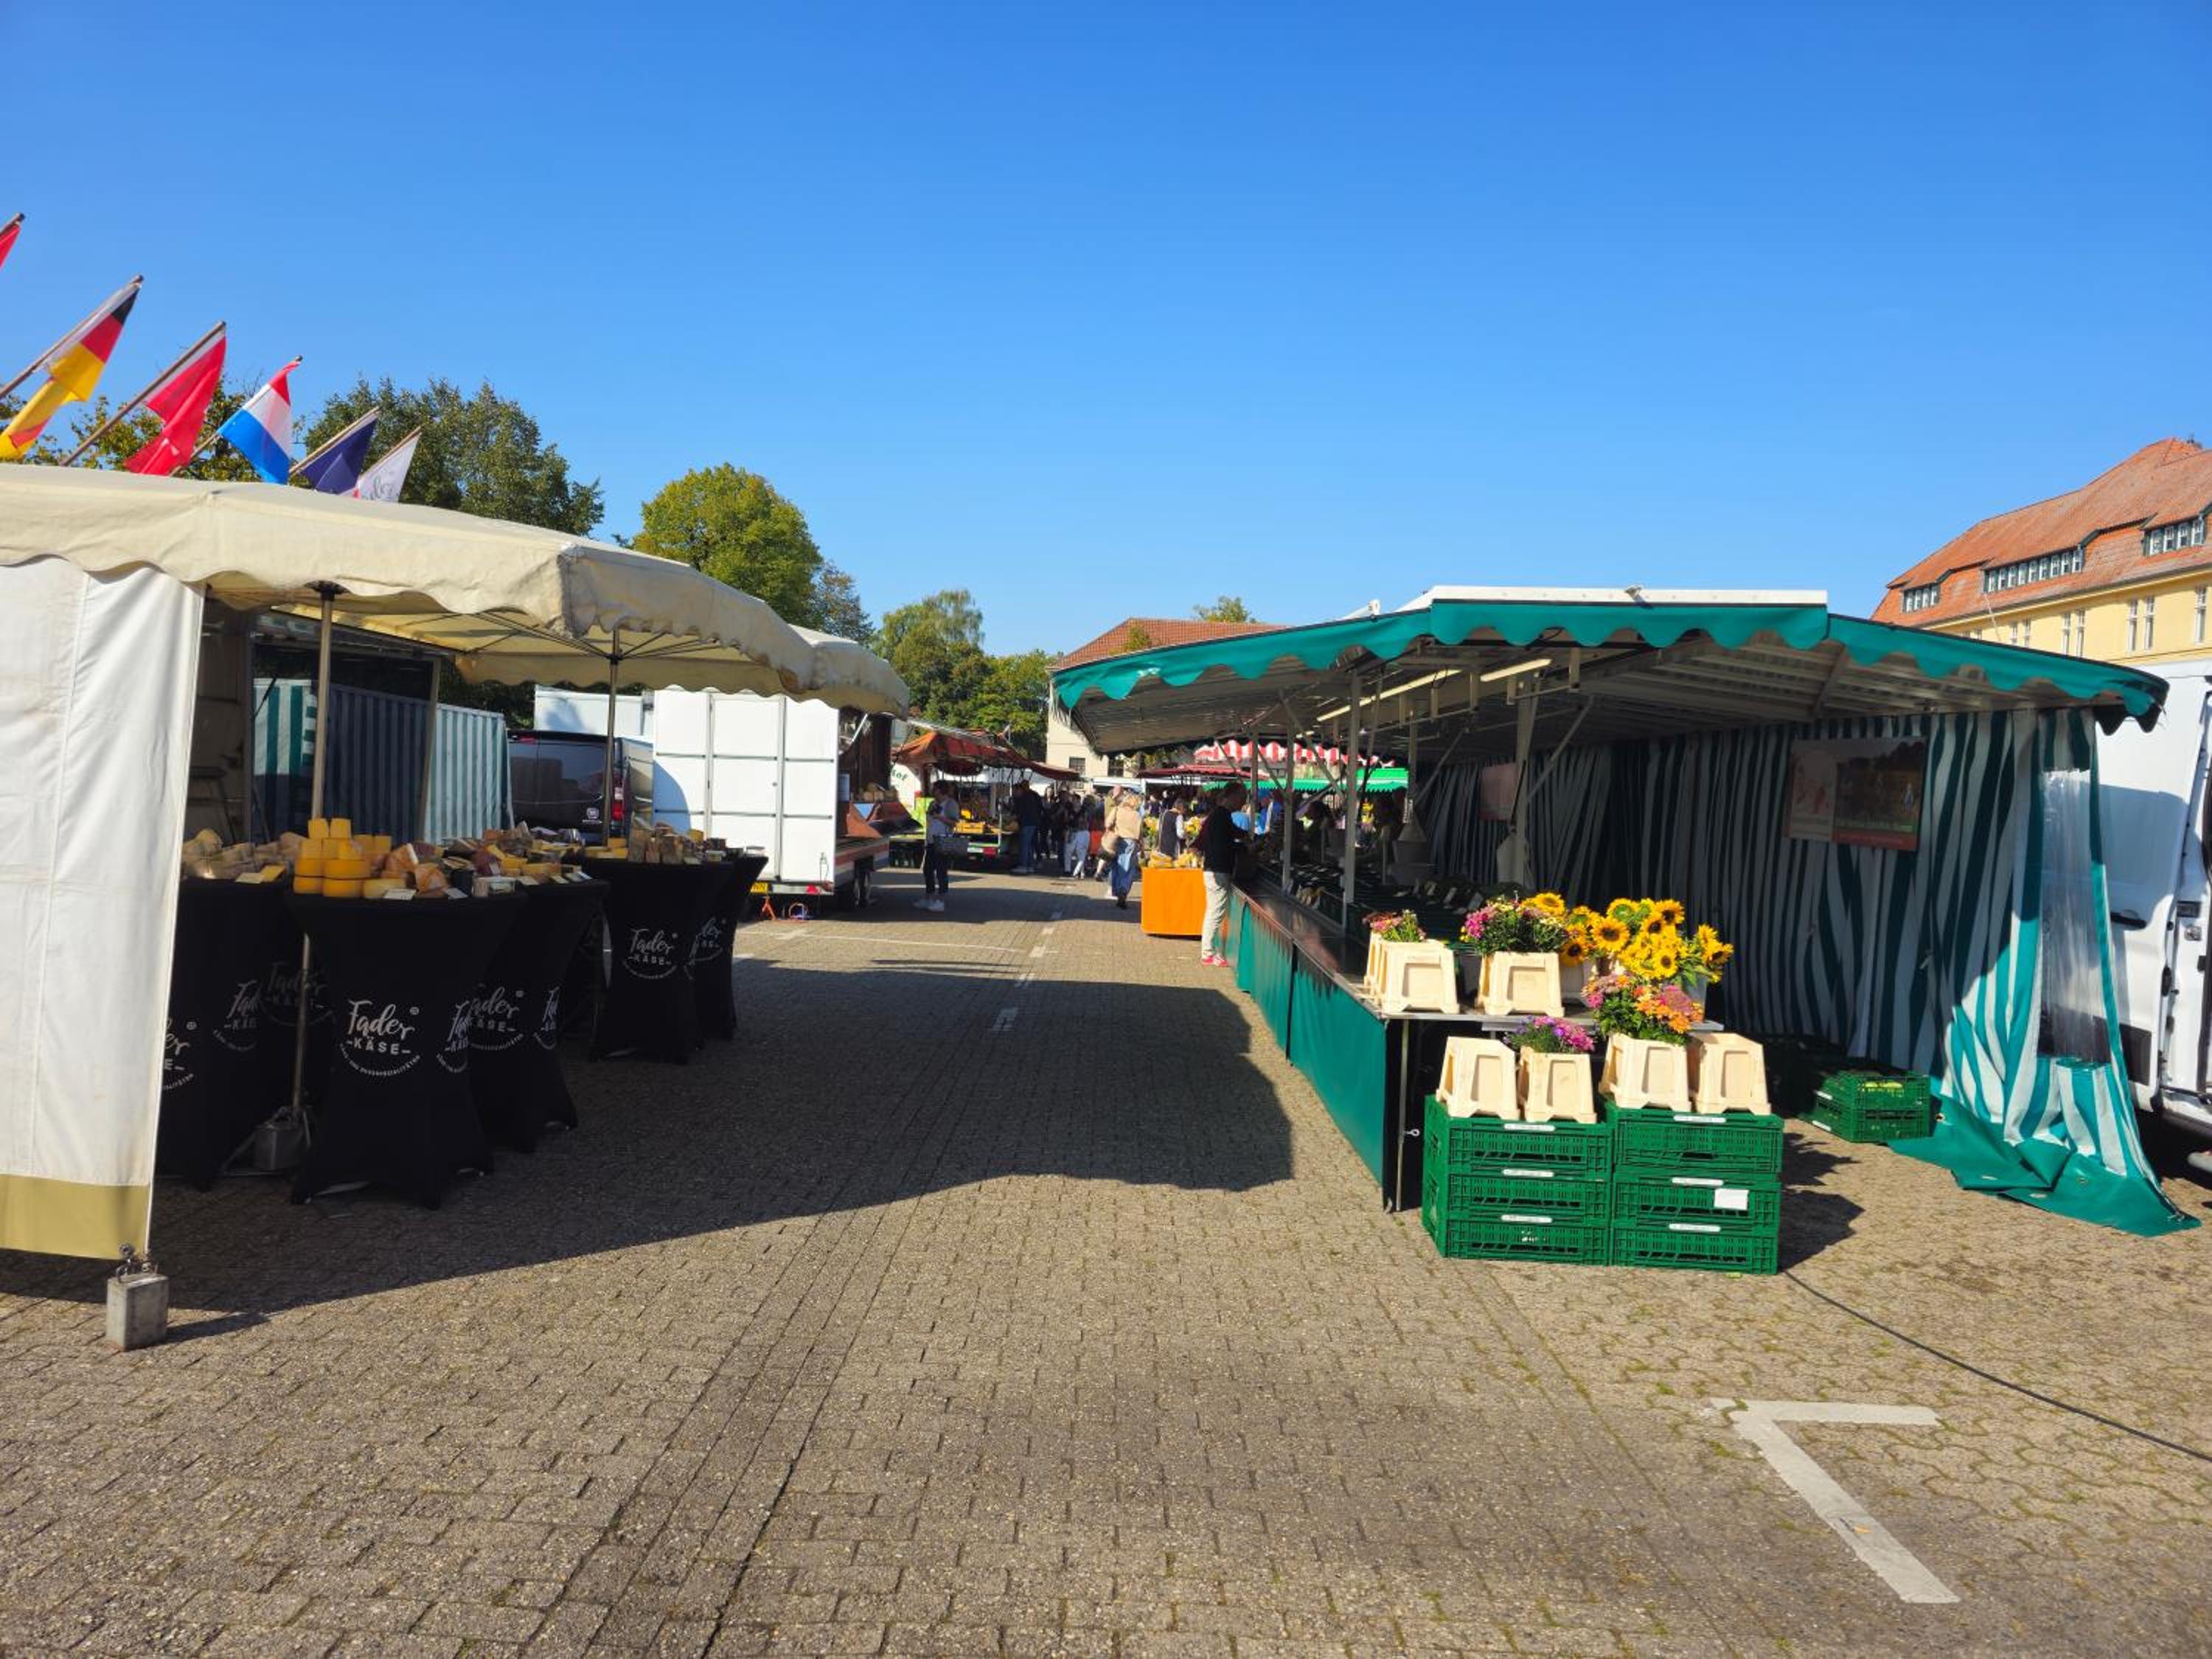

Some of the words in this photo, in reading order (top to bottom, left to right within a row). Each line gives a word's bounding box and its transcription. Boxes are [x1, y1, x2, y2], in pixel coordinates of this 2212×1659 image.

[630, 928, 673, 955] Fader
[470, 986, 520, 1019] ader
[347, 999, 415, 1041] Fader
[477, 1015, 507, 1032] ÄSE
[354, 1036, 400, 1055] KÄSE
